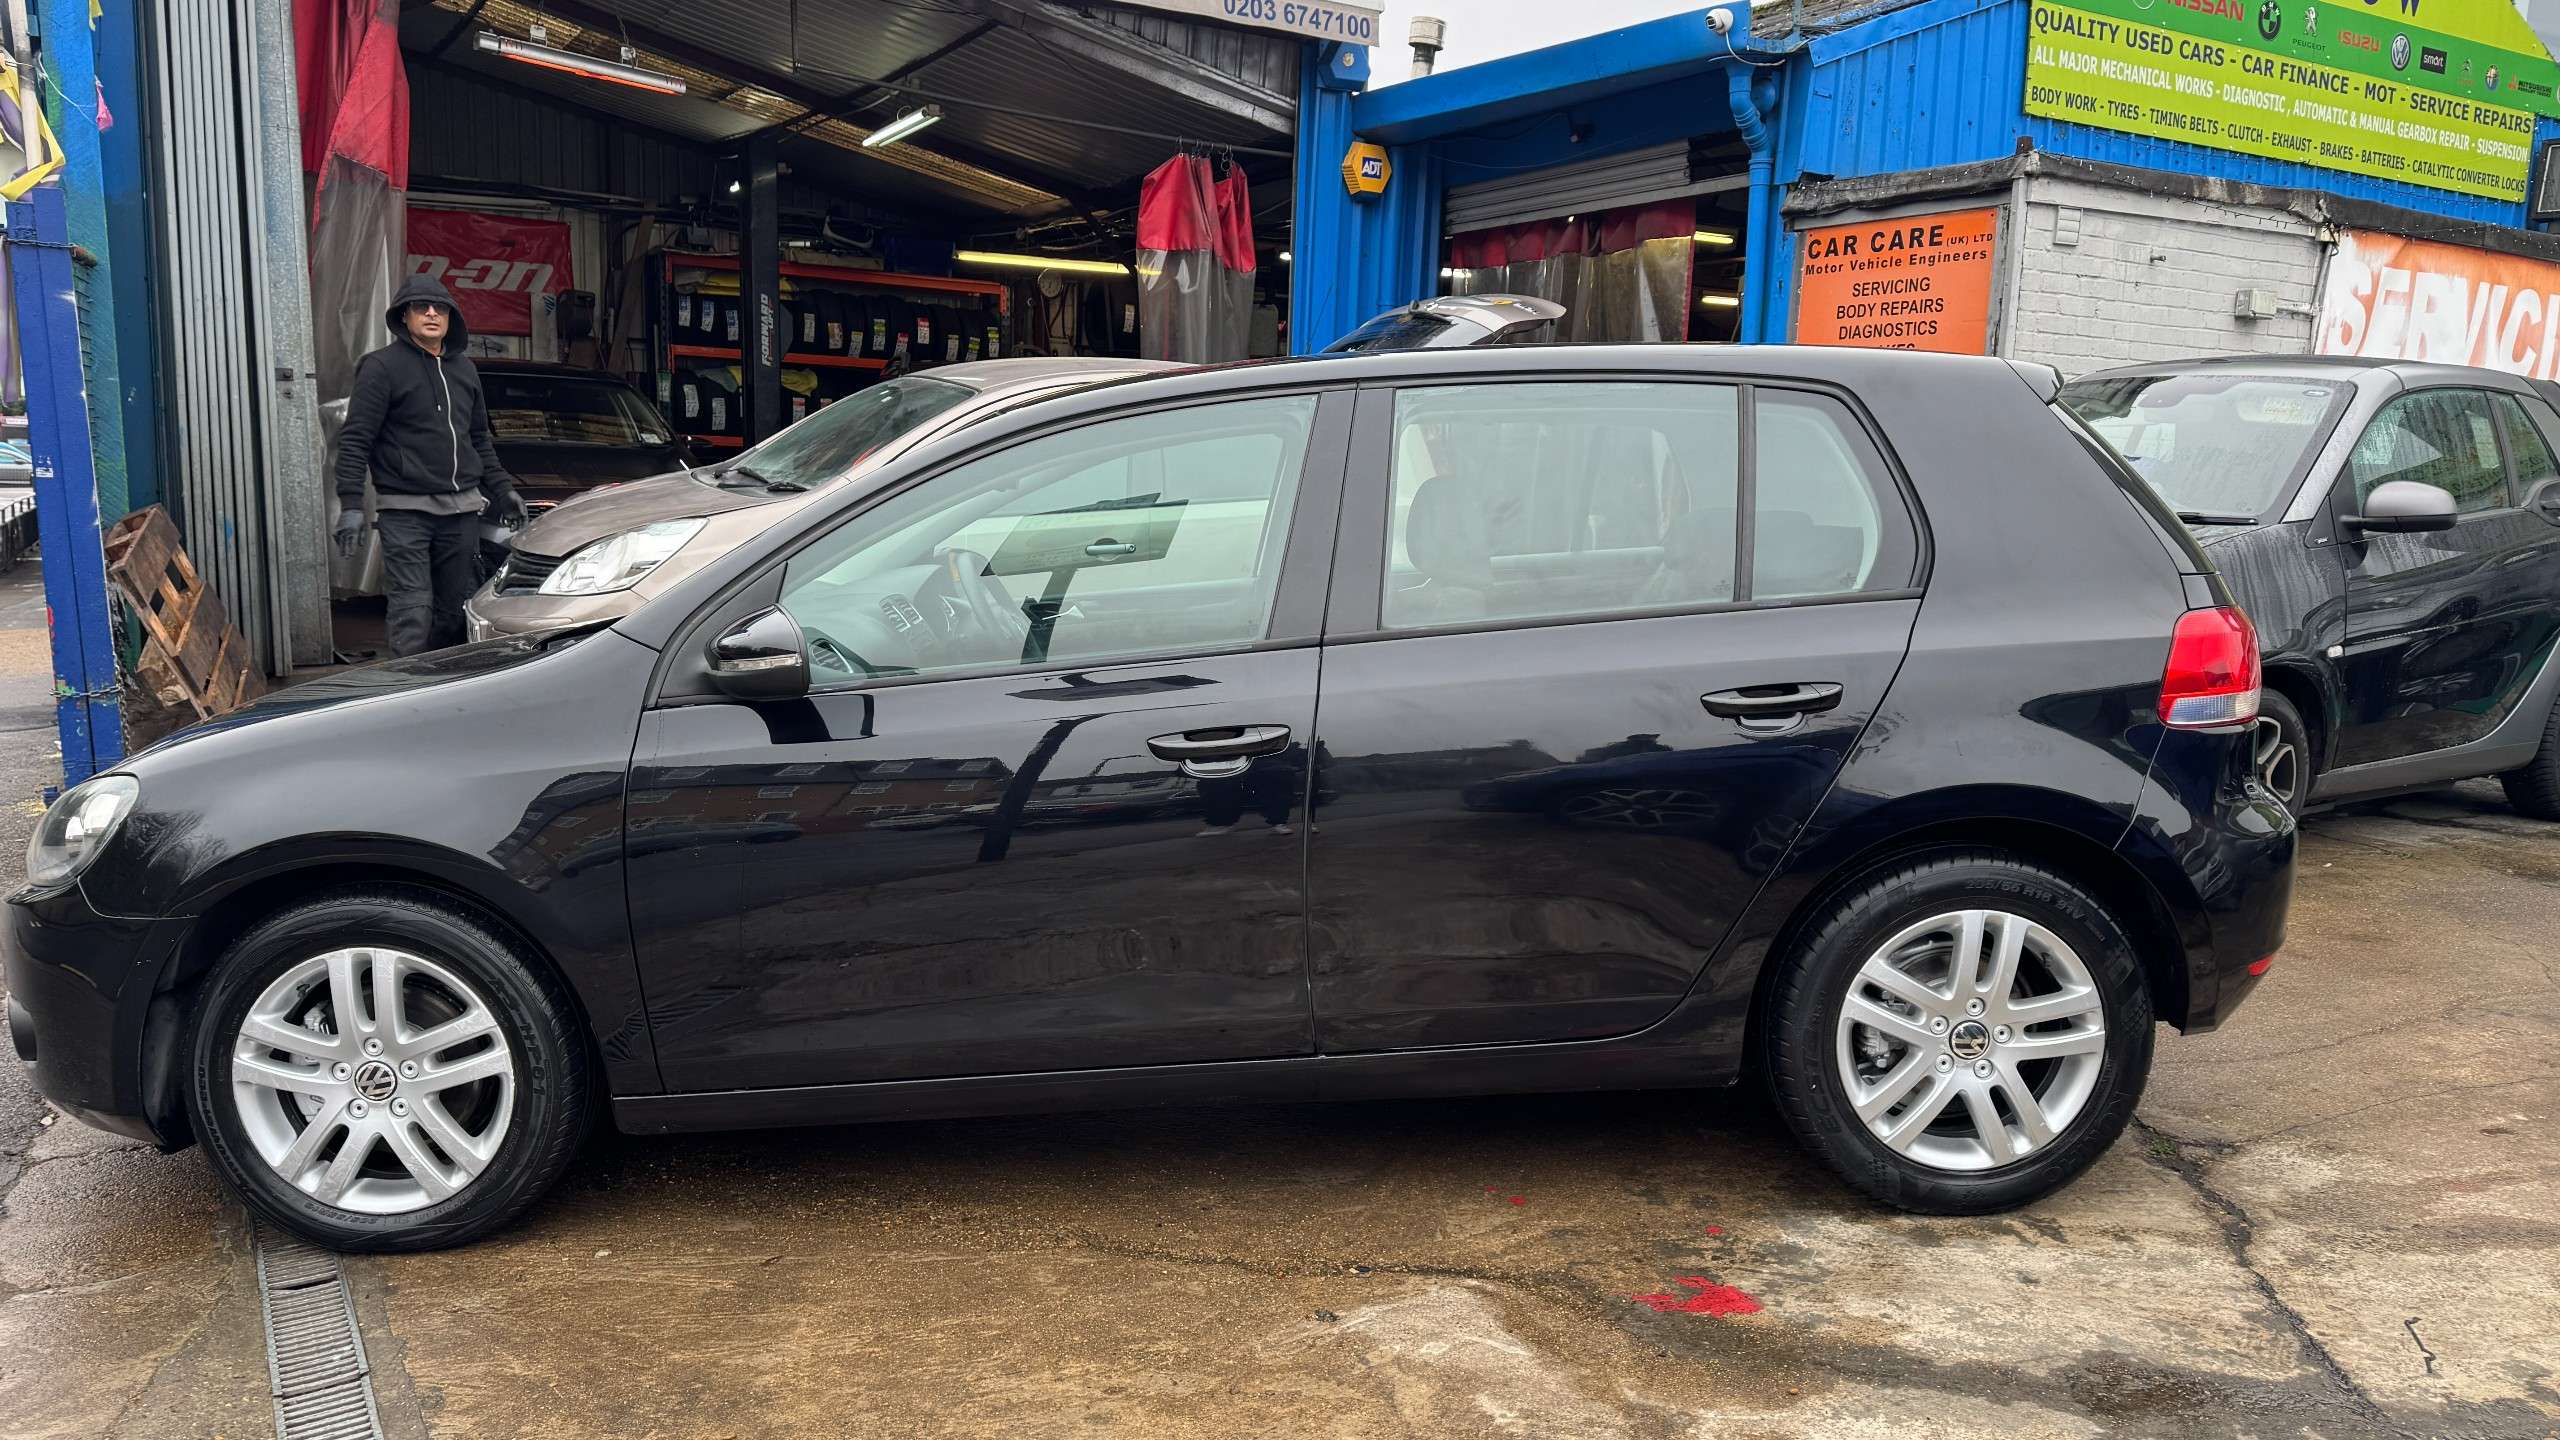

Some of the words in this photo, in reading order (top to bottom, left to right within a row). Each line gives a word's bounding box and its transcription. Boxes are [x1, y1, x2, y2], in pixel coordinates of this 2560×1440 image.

[1224, 0, 1276, 21] 0203
[1284, 3, 1370, 38] 6747100
[2292, 38, 2326, 51] PEUGEOT
[2034, 8, 2120, 43] QUALITY
[2126, 27, 2174, 55] USED
[2179, 39, 2225, 66] CARS
[2242, 54, 2274, 78] CAR
[2280, 62, 2349, 94] FINANCE
[2364, 81, 2396, 104] MOT
[2410, 92, 2470, 121] SERVICE
[2473, 105, 2531, 133] REPAIRS
[2424, 54, 2444, 67] smart
[2034, 45, 2055, 67] ALL
[2058, 49, 2098, 75] MAJOR
[2100, 58, 2172, 90] MECHANICAL
[2175, 73, 2214, 98] WORKS
[2223, 83, 2286, 113] DIAGNOSTIC
[2292, 100, 2348, 126] AUTOMATIC
[2349, 111, 2357, 128] &
[2359, 113, 2395, 136] MANUAL
[2397, 121, 2438, 145] GEARBOX
[2439, 129, 2470, 151] REPAIR
[2477, 138, 2529, 163] SUSPENSION
[2031, 85, 2062, 106] BODY
[2065, 91, 2098, 113] WORK
[2107, 100, 2140, 121] TYRES
[2150, 108, 2187, 129] TIMING
[2190, 116, 2219, 135] BELTS
[2227, 123, 2263, 144] CLUTCH
[2271, 131, 2312, 153] EXHAUST
[2320, 141, 2353, 161] BRAKES
[2361, 149, 2406, 171] BATTERIES
[2412, 159, 2455, 180] CATALYTIC
[2456, 167, 2500, 189] CONVERTER
[2501, 176, 2525, 193] LOCKS
[1362, 160, 1382, 176] ADT
[1808, 235, 1857, 260] CAR
[1870, 224, 1945, 253] CARE
[1946, 235, 1969, 248] (UK)
[1973, 232, 1994, 245] LTD
[1805, 262, 1844, 276] Motor
[1849, 255, 1903, 272] Vehicle
[1908, 248, 1988, 268] Engineers
[1852, 276, 1931, 298] SERVICING
[1836, 302, 1877, 320] BODY
[1880, 297, 1945, 317] REPAIRS
[760, 293, 771, 367] FORWARD
[1838, 320, 1938, 341] DIAGNOSTICS
